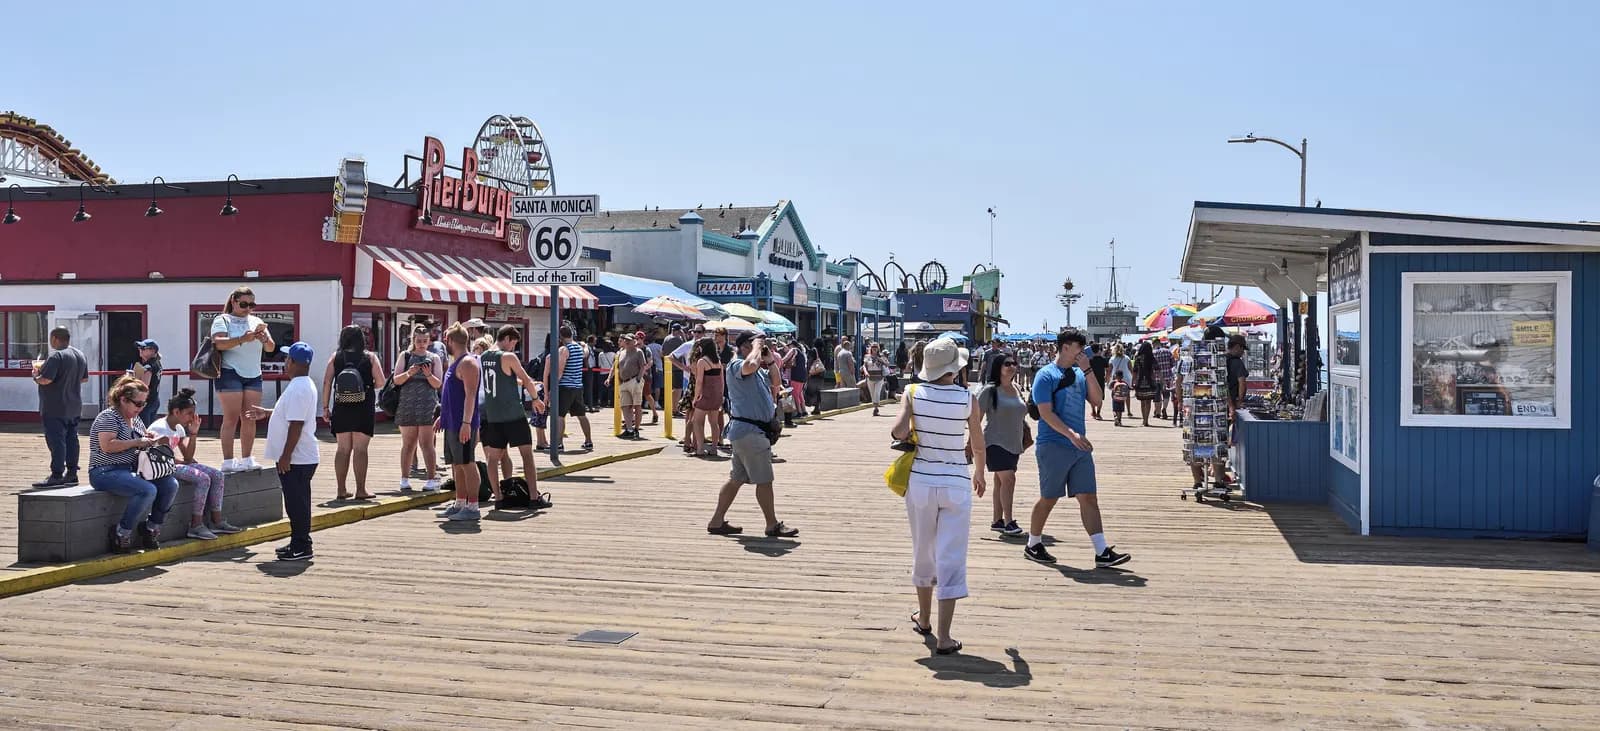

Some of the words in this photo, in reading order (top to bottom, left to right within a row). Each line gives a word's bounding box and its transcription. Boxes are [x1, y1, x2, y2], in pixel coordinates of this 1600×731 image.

[515, 200, 547, 214] SANTA
[551, 199, 593, 213] MONICA
[535, 226, 572, 261] 66
[515, 271, 534, 283] End
[538, 271, 549, 282] of
[551, 271, 567, 282] the
[570, 270, 592, 282] Trail
[699, 283, 751, 292] PLAYLAND
[1517, 405, 1537, 413] END
